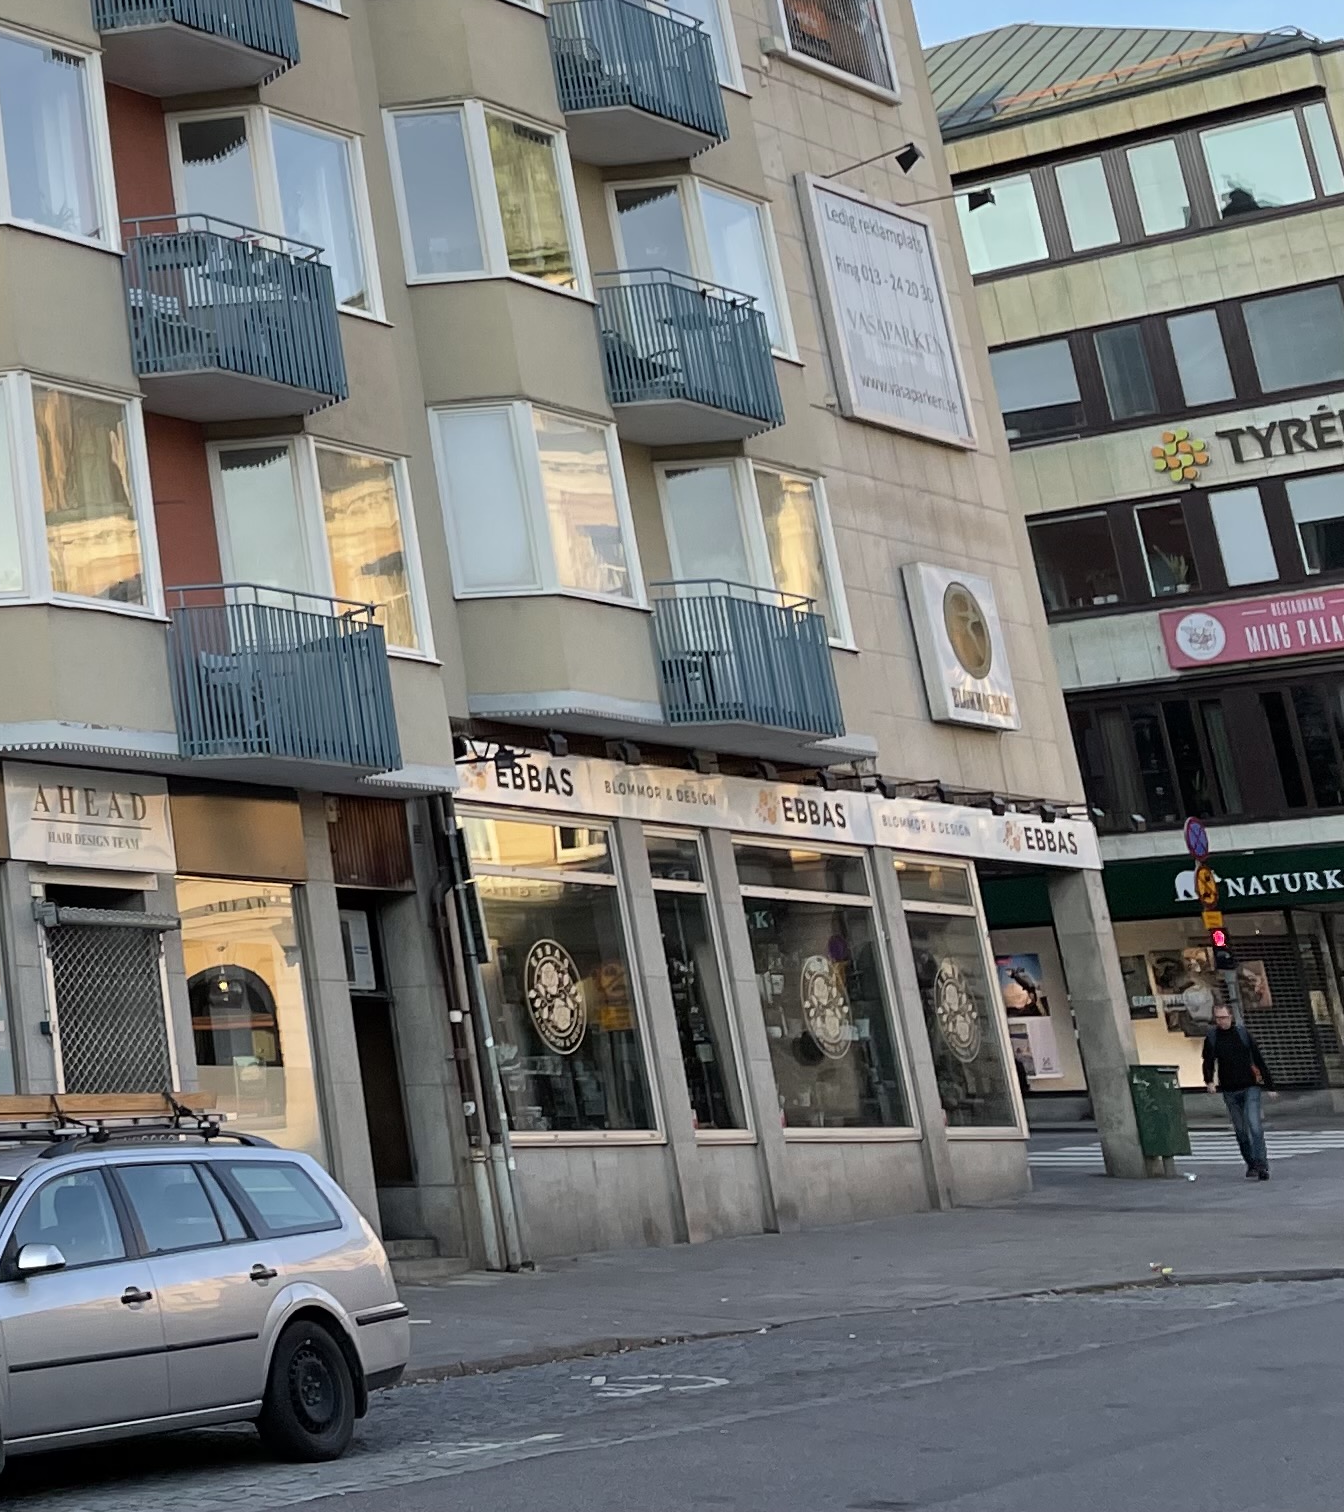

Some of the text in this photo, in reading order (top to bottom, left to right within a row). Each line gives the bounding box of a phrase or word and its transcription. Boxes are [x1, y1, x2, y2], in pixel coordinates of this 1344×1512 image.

[824, 202, 924, 254] Ledig reklamplats
[835, 255, 861, 283] Ring
[1215, 404, 1344, 464] TYRÉ
[1245, 615, 1344, 653] MING PALA
[495, 762, 574, 797] EBBAS
[604, 780, 717, 807] BLOMMOR & DESIGN
[33, 784, 148, 821] AHEAD
[781, 796, 846, 829] EBBAS
[48, 831, 140, 850] HAIR DESIGN TEAM
[882, 814, 929, 833] BLOMMOR
[938, 822, 971, 838] DESIGN
[1023, 826, 1078, 856] EBBAS
[1224, 868, 1344, 898] NATURK
